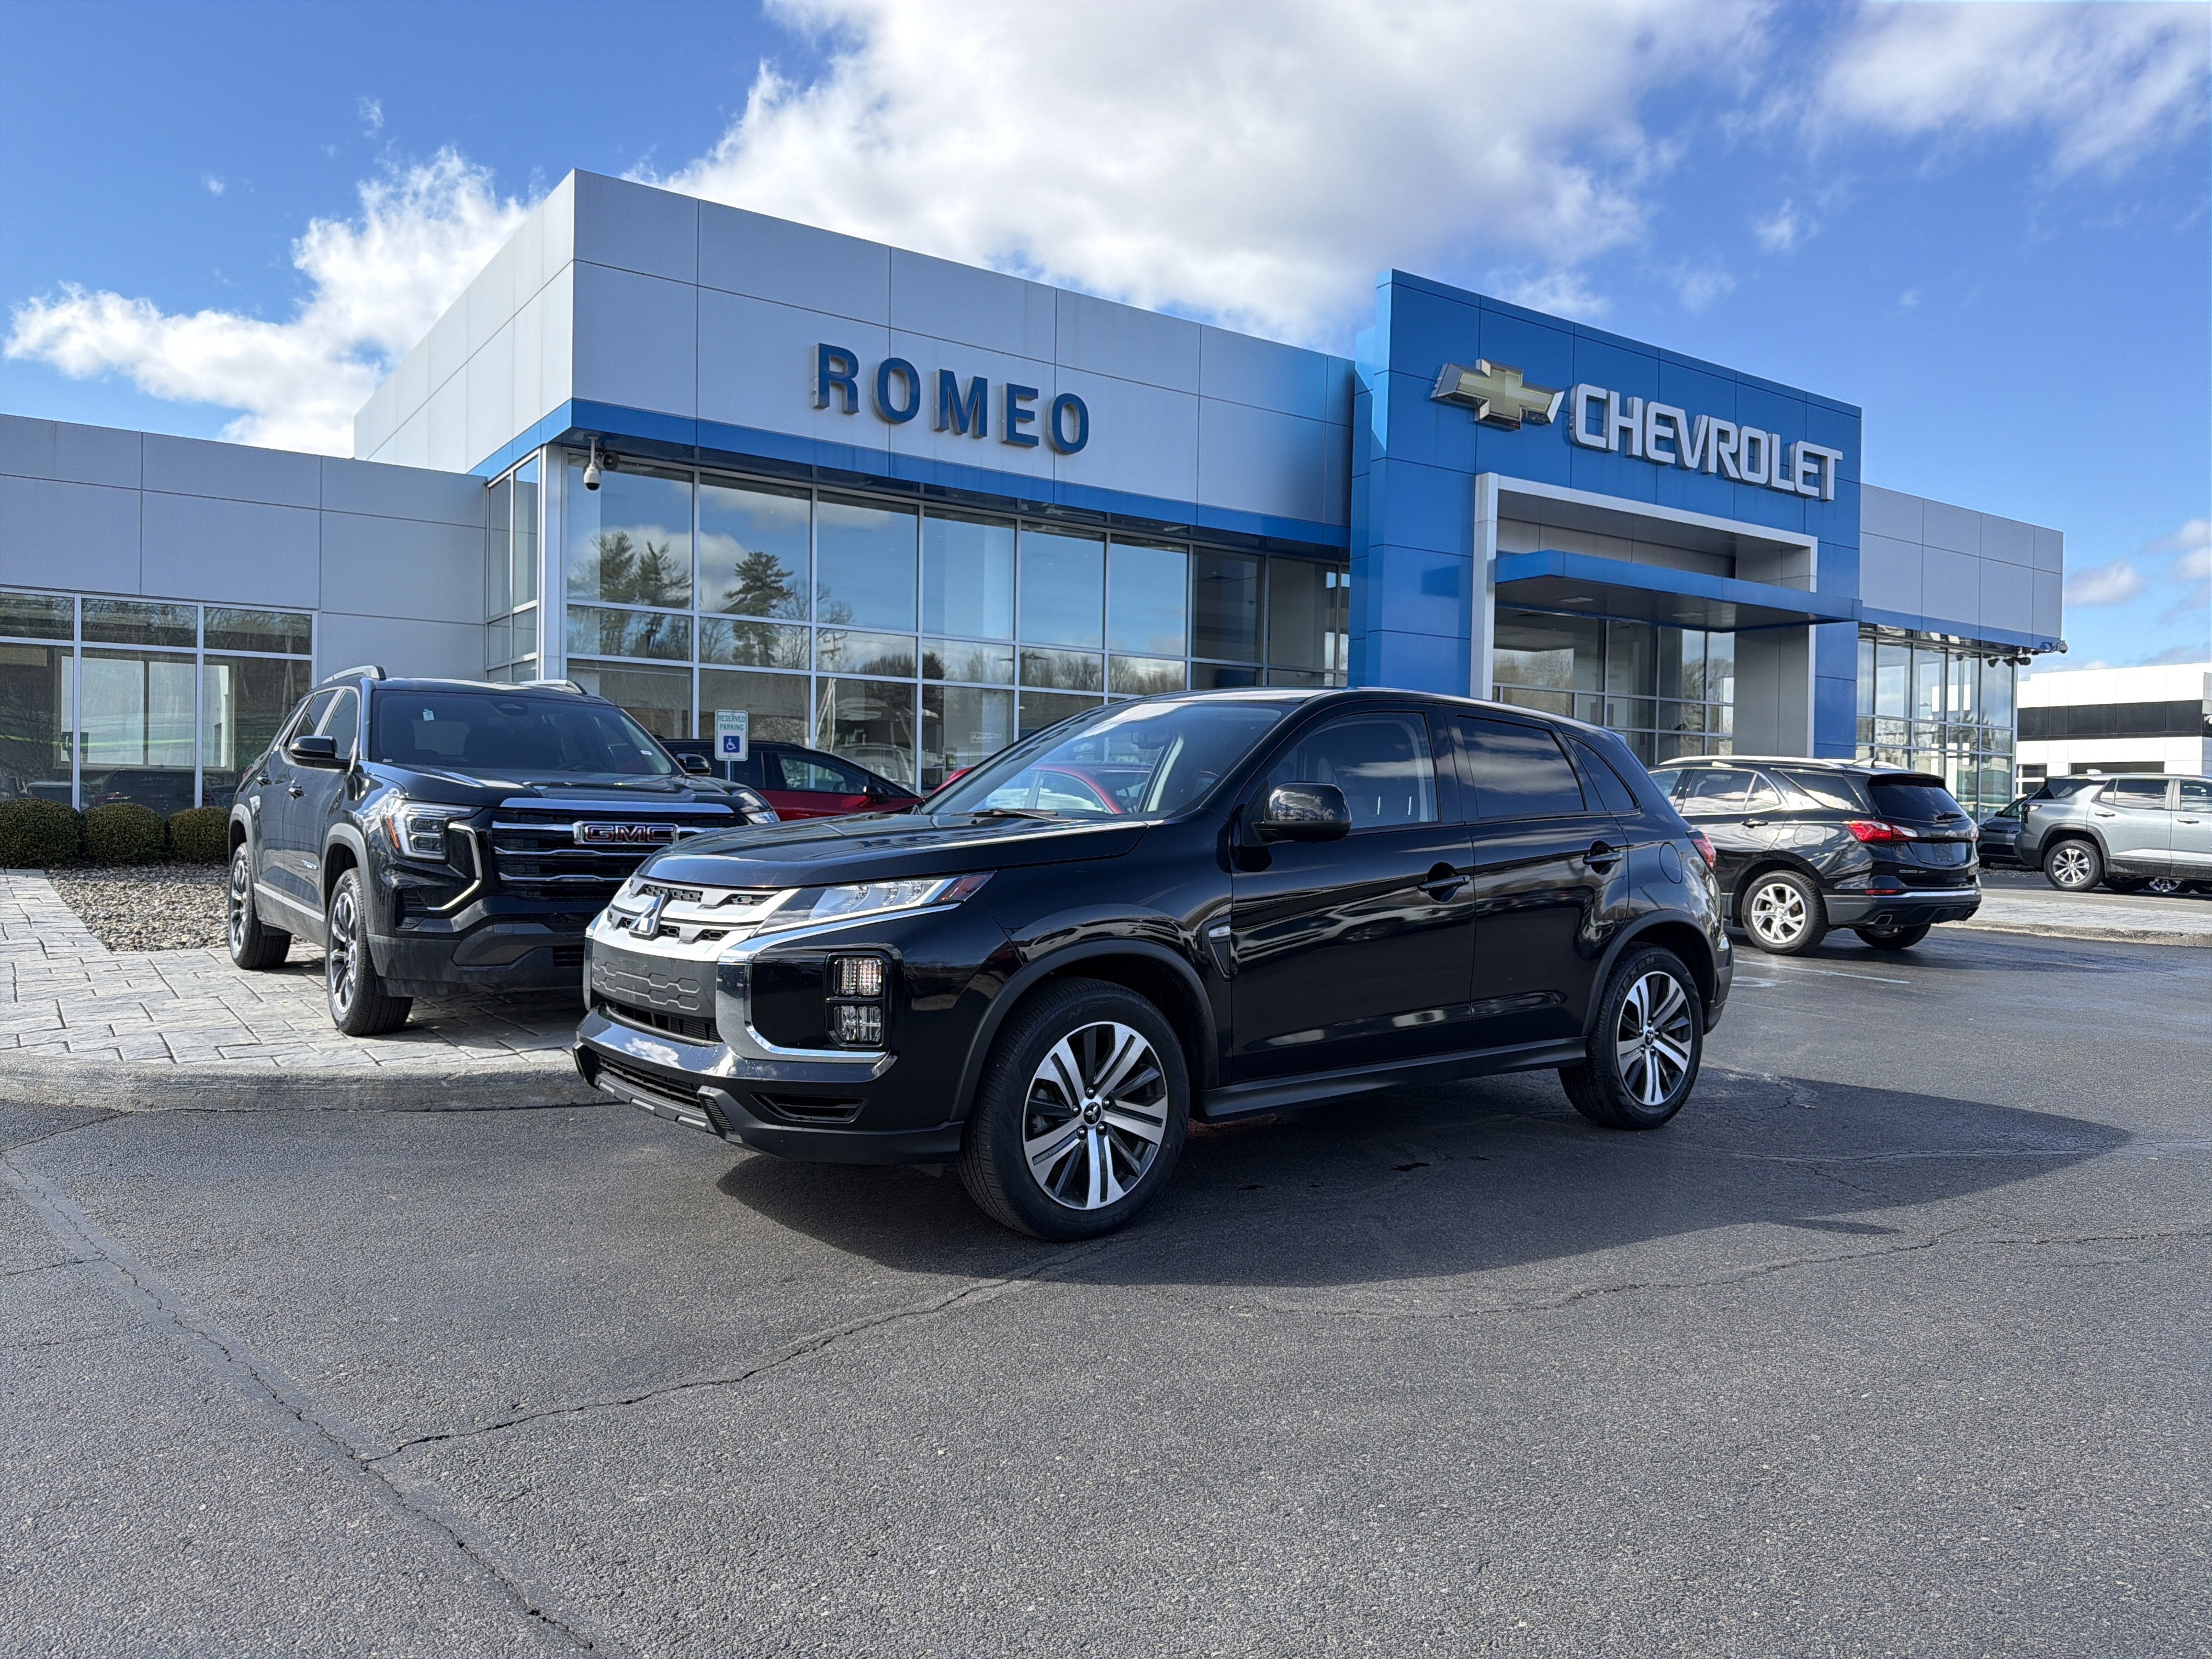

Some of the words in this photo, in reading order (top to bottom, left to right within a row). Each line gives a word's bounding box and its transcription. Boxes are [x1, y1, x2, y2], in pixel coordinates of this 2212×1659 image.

[813, 343, 1089, 454] ROMEO
[1569, 383, 1843, 501] CHEVROLET
[585, 825, 675, 843] GMC
